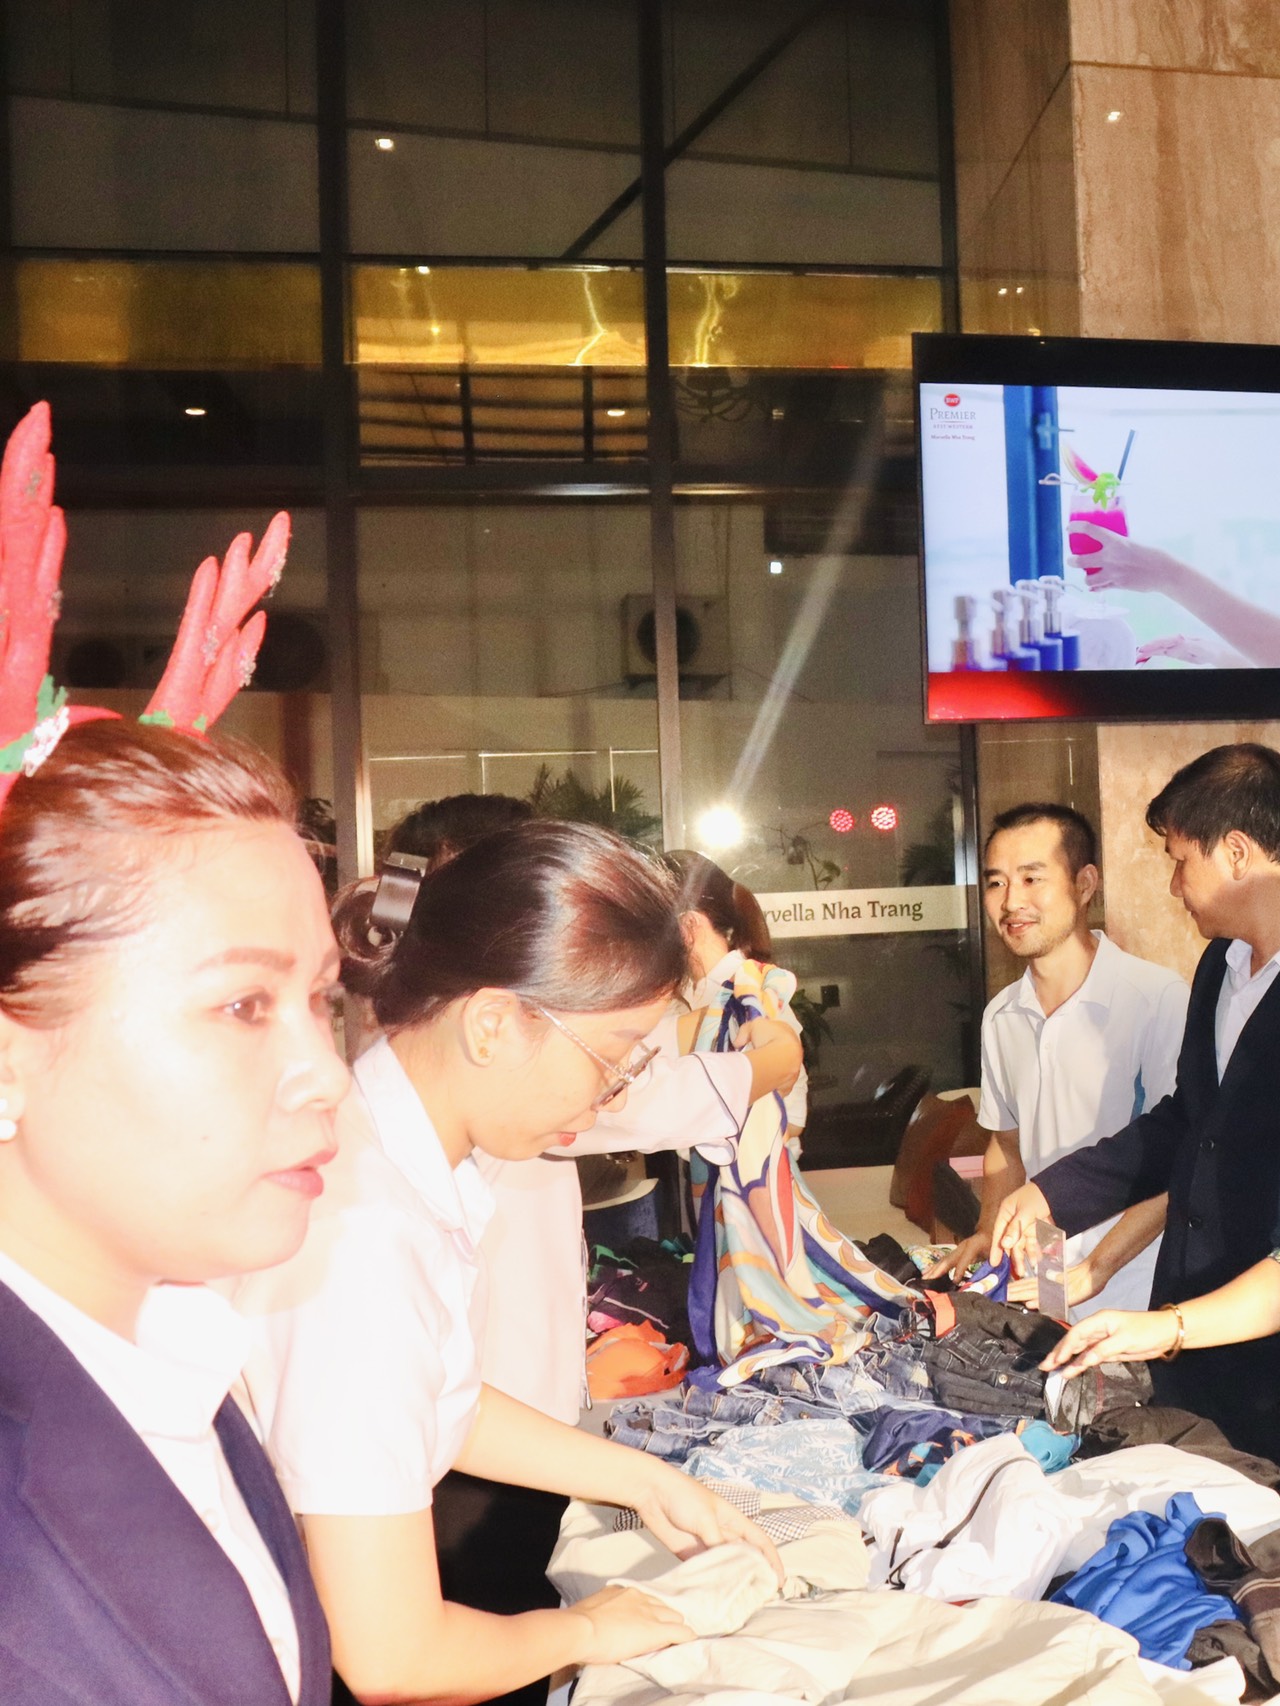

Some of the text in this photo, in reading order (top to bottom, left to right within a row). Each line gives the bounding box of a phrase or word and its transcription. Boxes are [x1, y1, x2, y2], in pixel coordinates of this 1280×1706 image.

[930, 407, 976, 420] PREMIER
[763, 900, 924, 923] rvella Nha Trang
